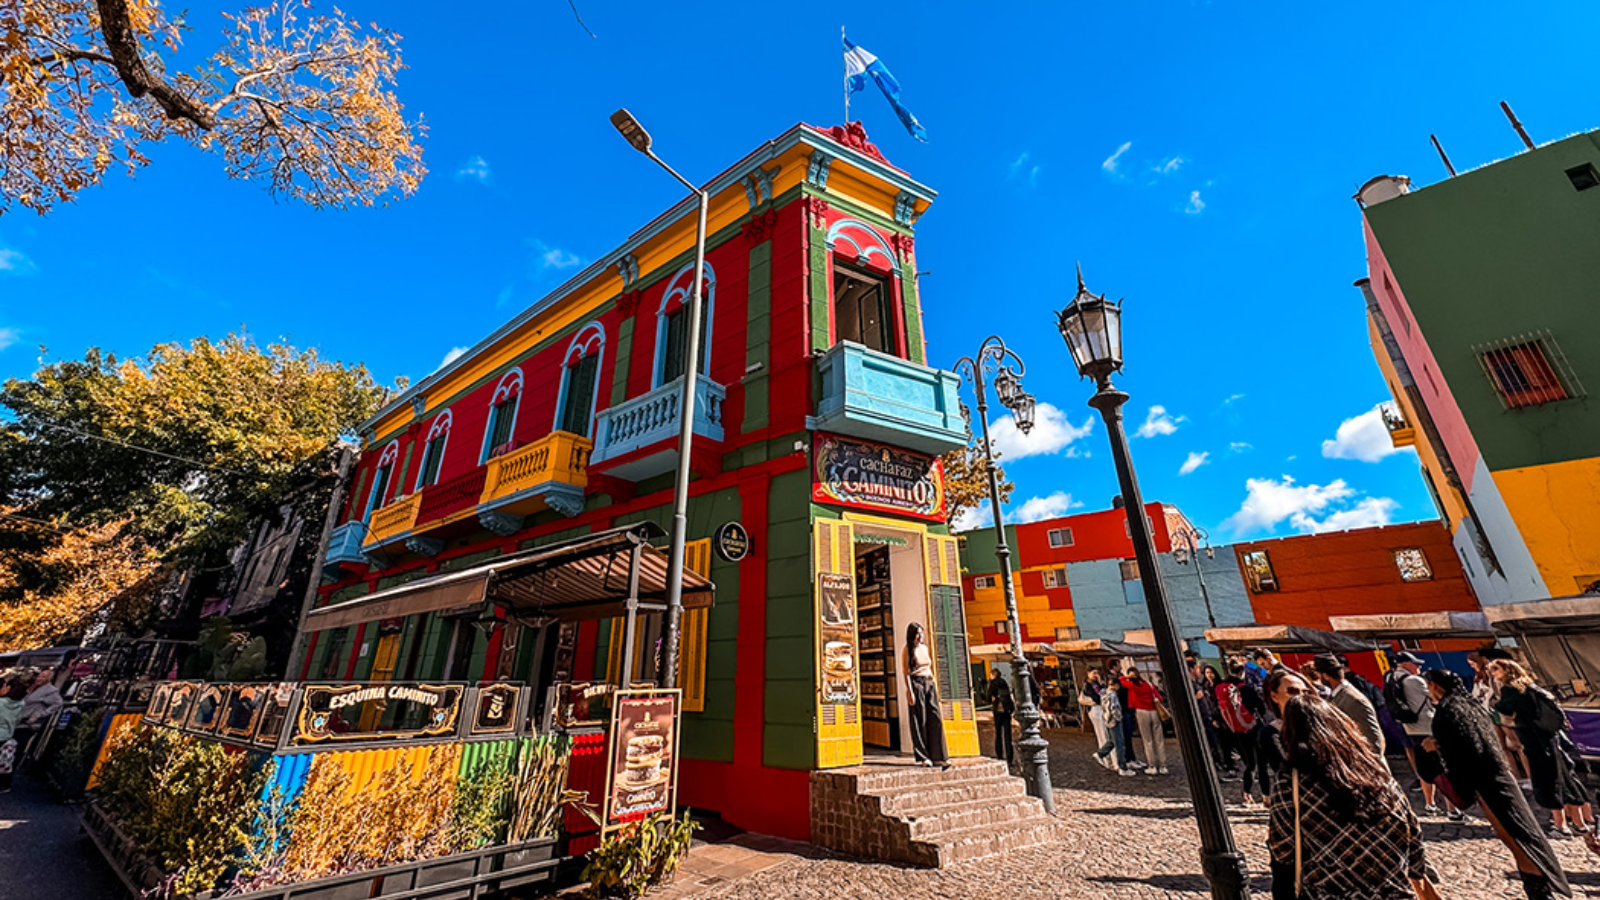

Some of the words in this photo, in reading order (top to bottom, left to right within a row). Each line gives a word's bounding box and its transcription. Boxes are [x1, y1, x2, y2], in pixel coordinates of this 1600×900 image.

[842, 466, 927, 505] CAMINITO
[329, 686, 386, 709] ESQUINA
[388, 685, 439, 706] CAMINITO
